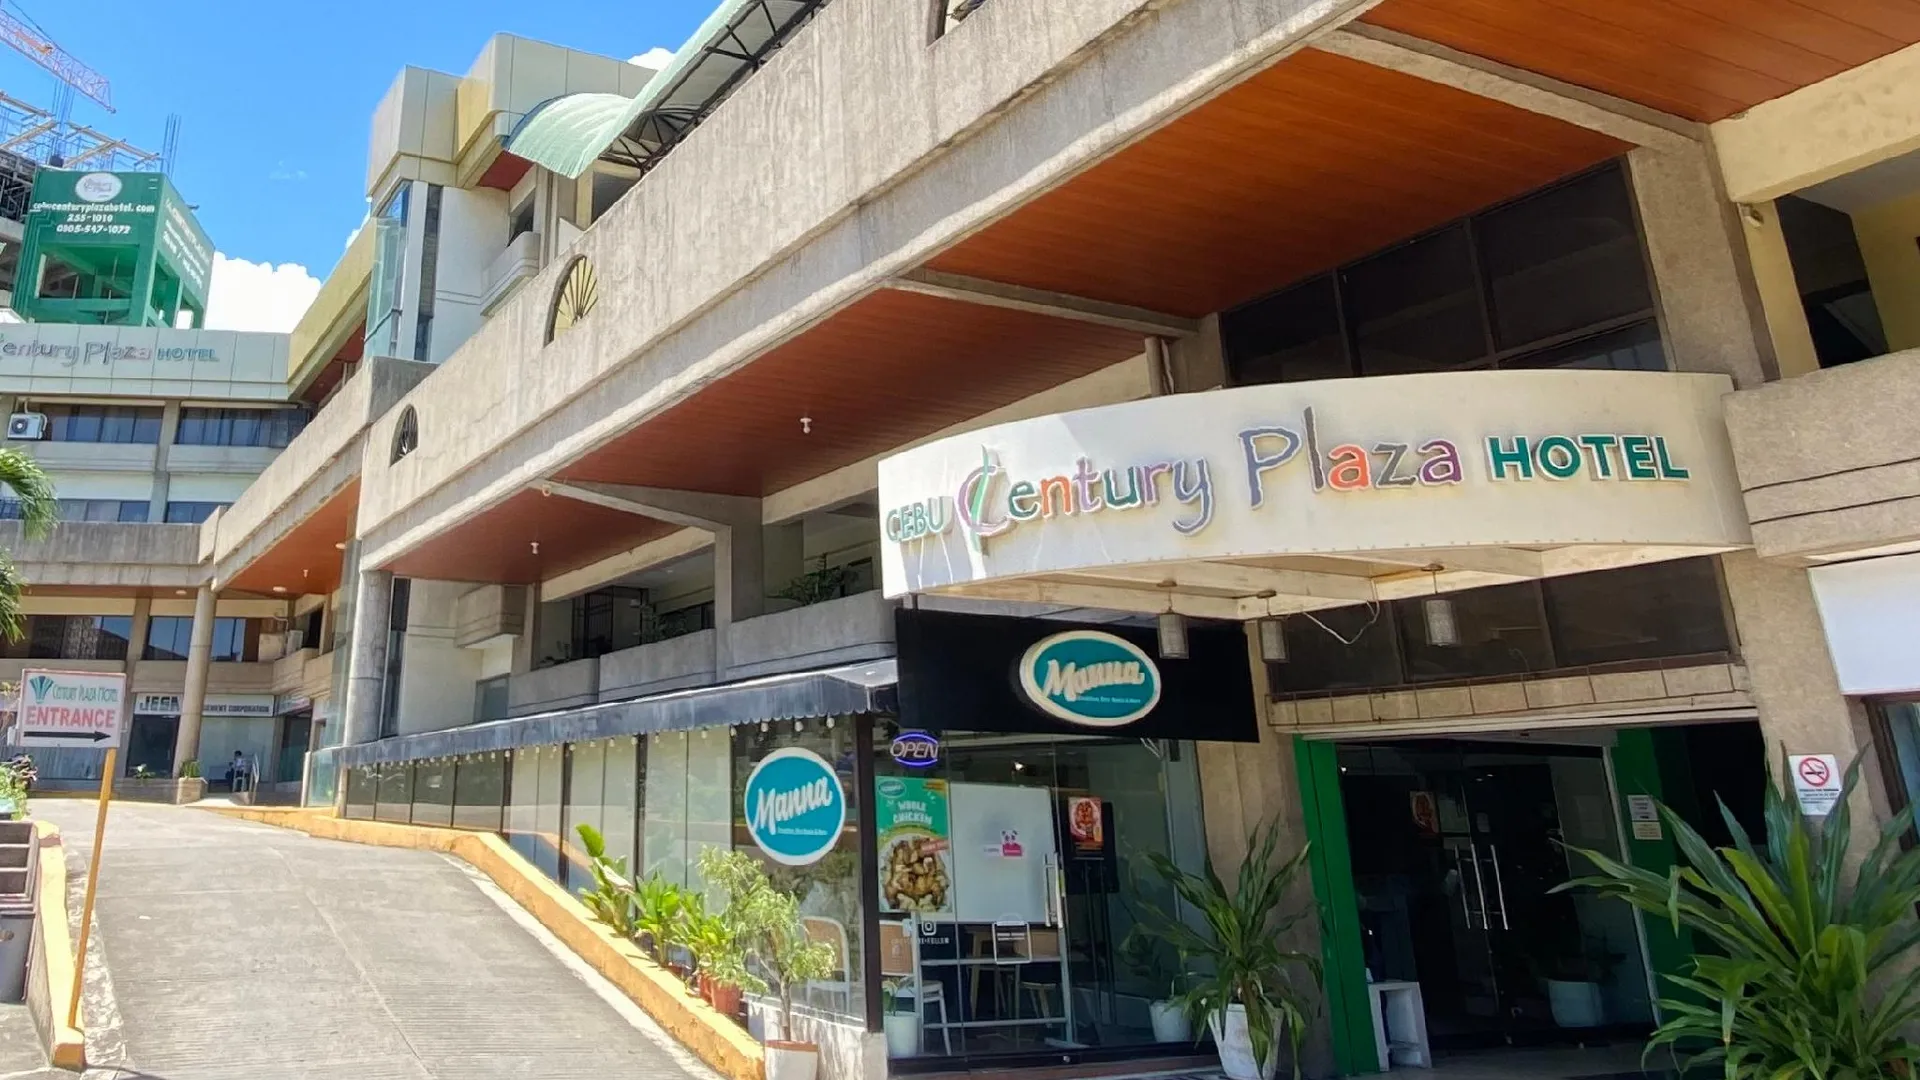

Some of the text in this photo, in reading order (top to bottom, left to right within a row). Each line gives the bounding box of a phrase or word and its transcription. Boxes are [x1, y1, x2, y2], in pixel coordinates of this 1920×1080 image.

[67, 213, 113, 222] 255-1010
[0, 333, 219, 367] entury Plaza HOTEL
[886, 404, 1691, 552] CEBU Century Plaza HOTEL
[1041, 659, 1145, 702] Manna
[25, 706, 116, 728] ENTRANCE
[890, 741, 938, 758] OPEN
[754, 776, 833, 835] Manna
[893, 811, 933, 825] CHICKEN
